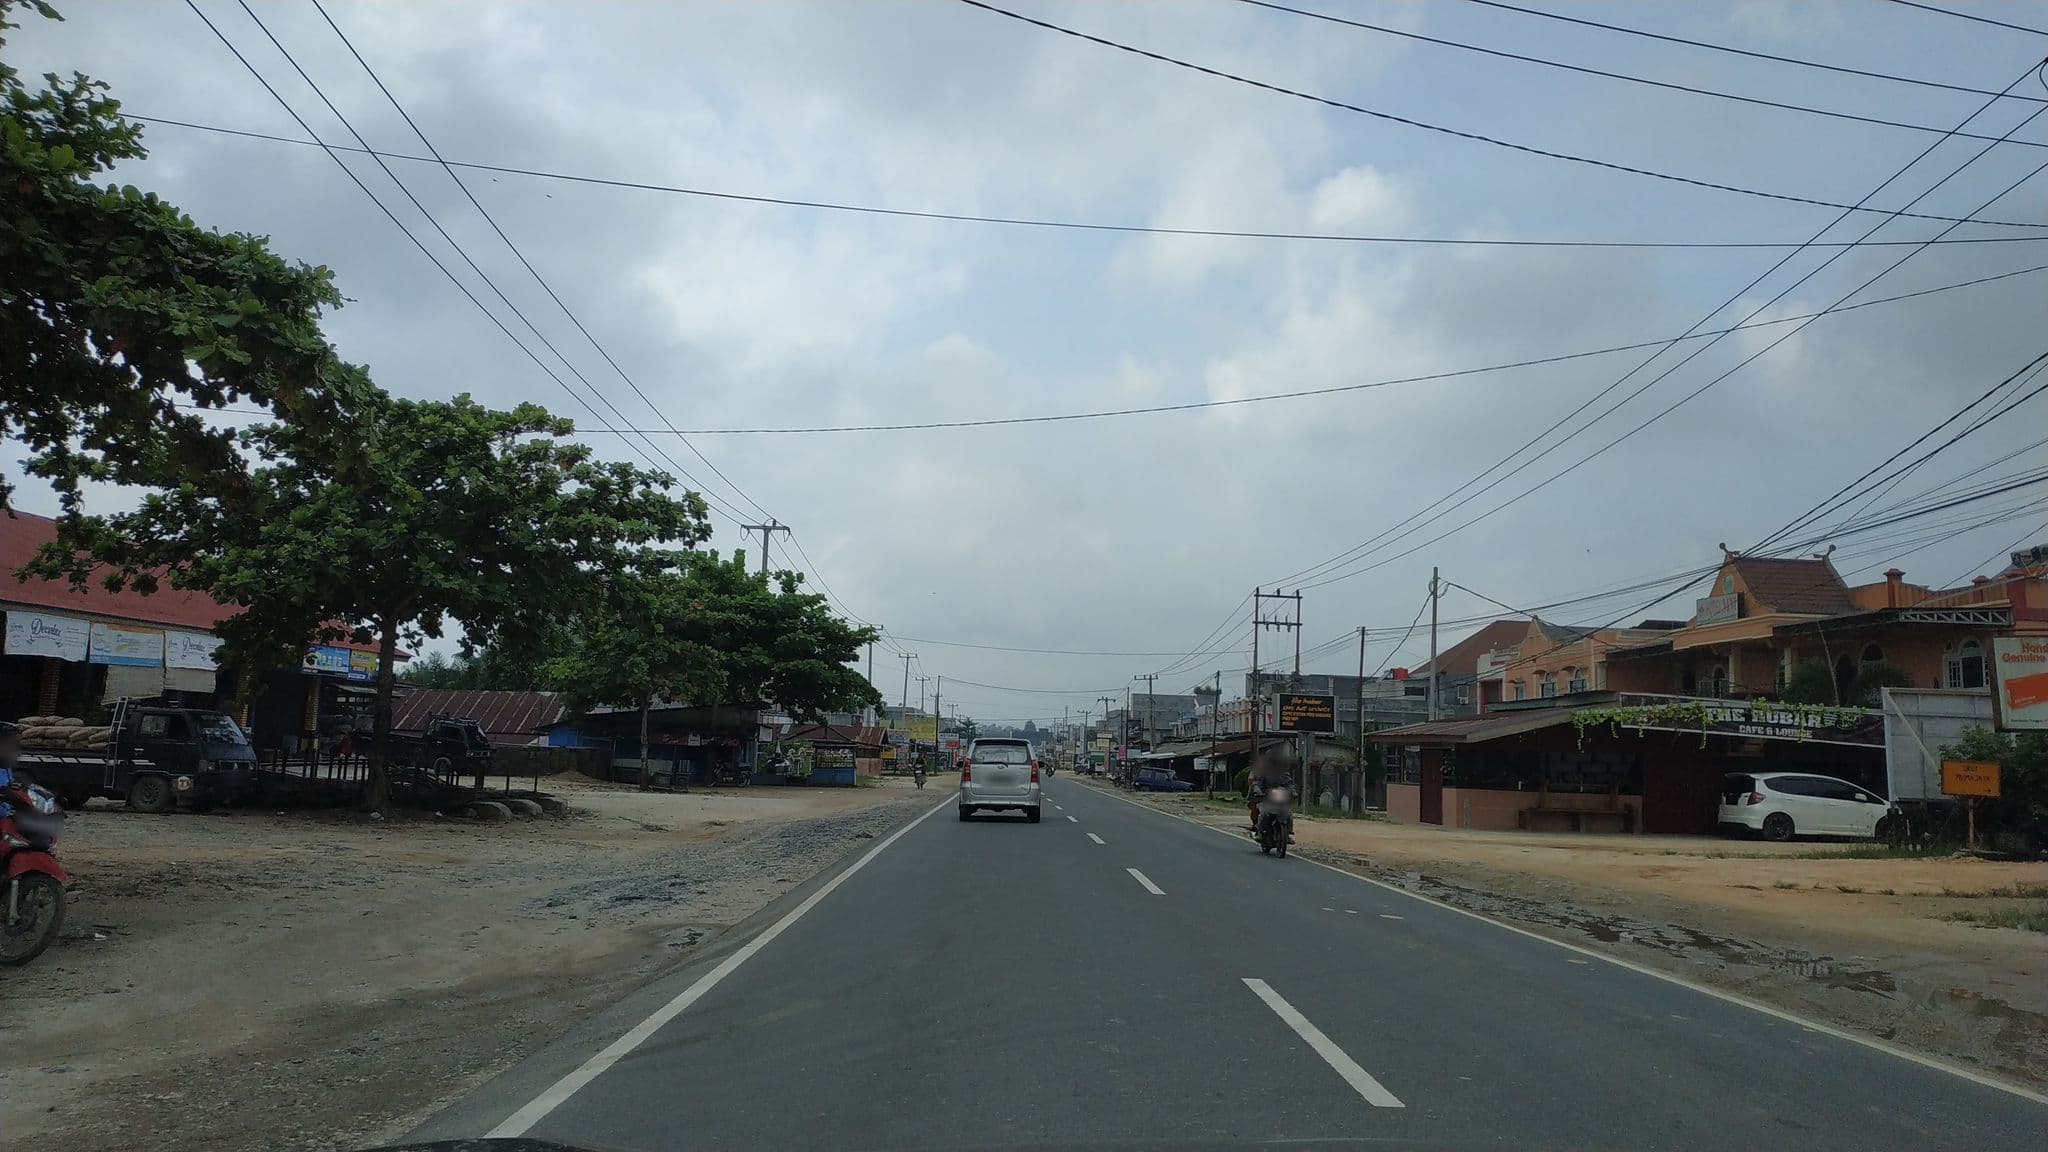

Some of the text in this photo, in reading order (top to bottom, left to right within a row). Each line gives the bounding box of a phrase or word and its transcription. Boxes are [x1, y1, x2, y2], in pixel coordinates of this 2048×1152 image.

[2002, 652, 2046, 663] Genuine
[1705, 707, 1746, 722] THE
[1739, 724, 1765, 735] CAFE
